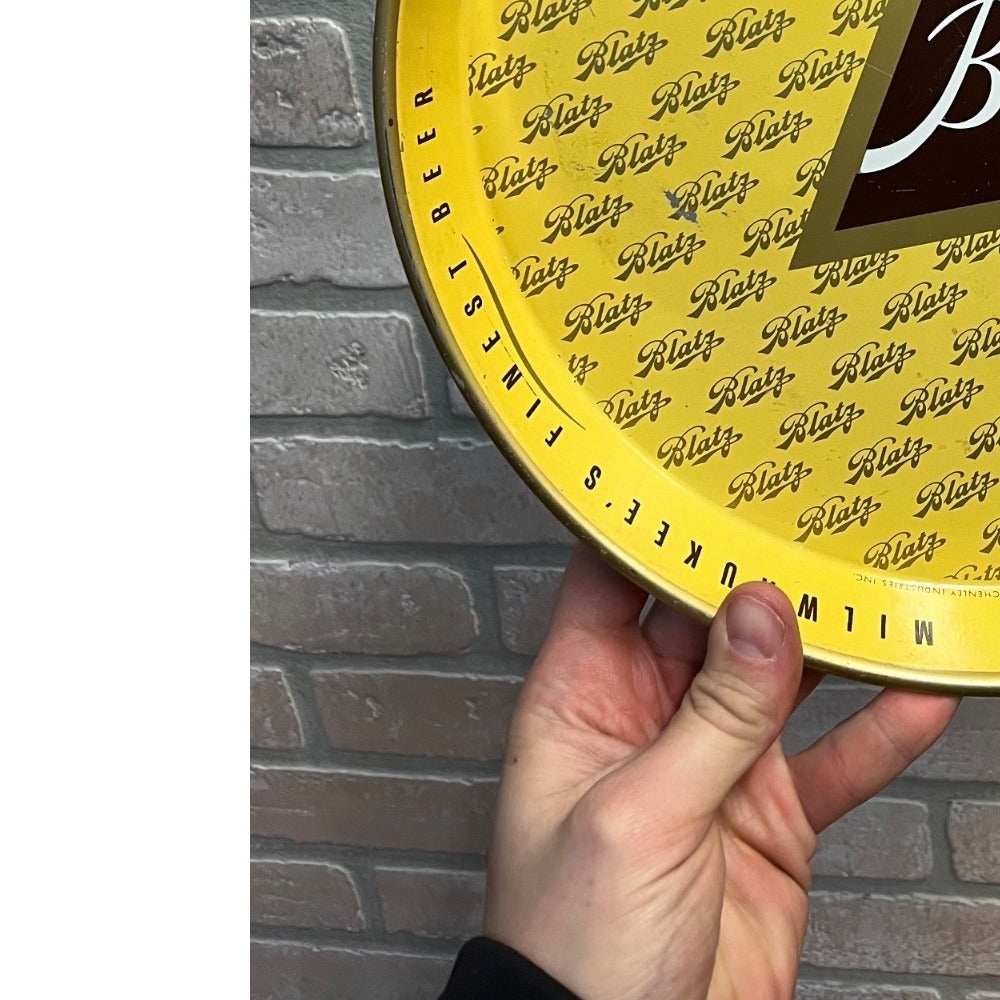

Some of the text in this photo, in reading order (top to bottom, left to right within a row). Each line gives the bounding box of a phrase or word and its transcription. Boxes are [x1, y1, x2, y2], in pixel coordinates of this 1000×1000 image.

[573, 30, 669, 82] Blatz
[702, 7, 796, 59] Blatz
[648, 71, 741, 122] Blatz
[774, 49, 866, 99] Blatz
[519, 93, 613, 145] Blatz
[721, 109, 813, 160] Blatz
[594, 132, 687, 183] Blatz
[541, 194, 634, 244] Blatz
[669, 170, 760, 221] Blatz
[614, 231, 707, 282] Blatz
[740, 208, 810, 258] Blat
[561, 292, 653, 343] Blatz
[687, 269, 777, 319] Blatz
[880, 281, 968, 331] Blatz
[634, 329, 725, 379] Blatz
[758, 305, 848, 355] Blatz
[413, 87, 934, 647] MILWUKEE'S FINEST BEER
[705, 366, 796, 415] Blatz
[827, 341, 917, 391] Blatz
[775, 401, 865, 450] Blatz
[896, 377, 985, 427] Blatz
[657, 425, 743, 470] Blatz
[844, 437, 933, 486] Blatz
[725, 461, 813, 510] Blatz
[913, 470, 1000, 519] Blatz
[793, 495, 882, 543] Blatz
[863, 531, 947, 571] Blatz
